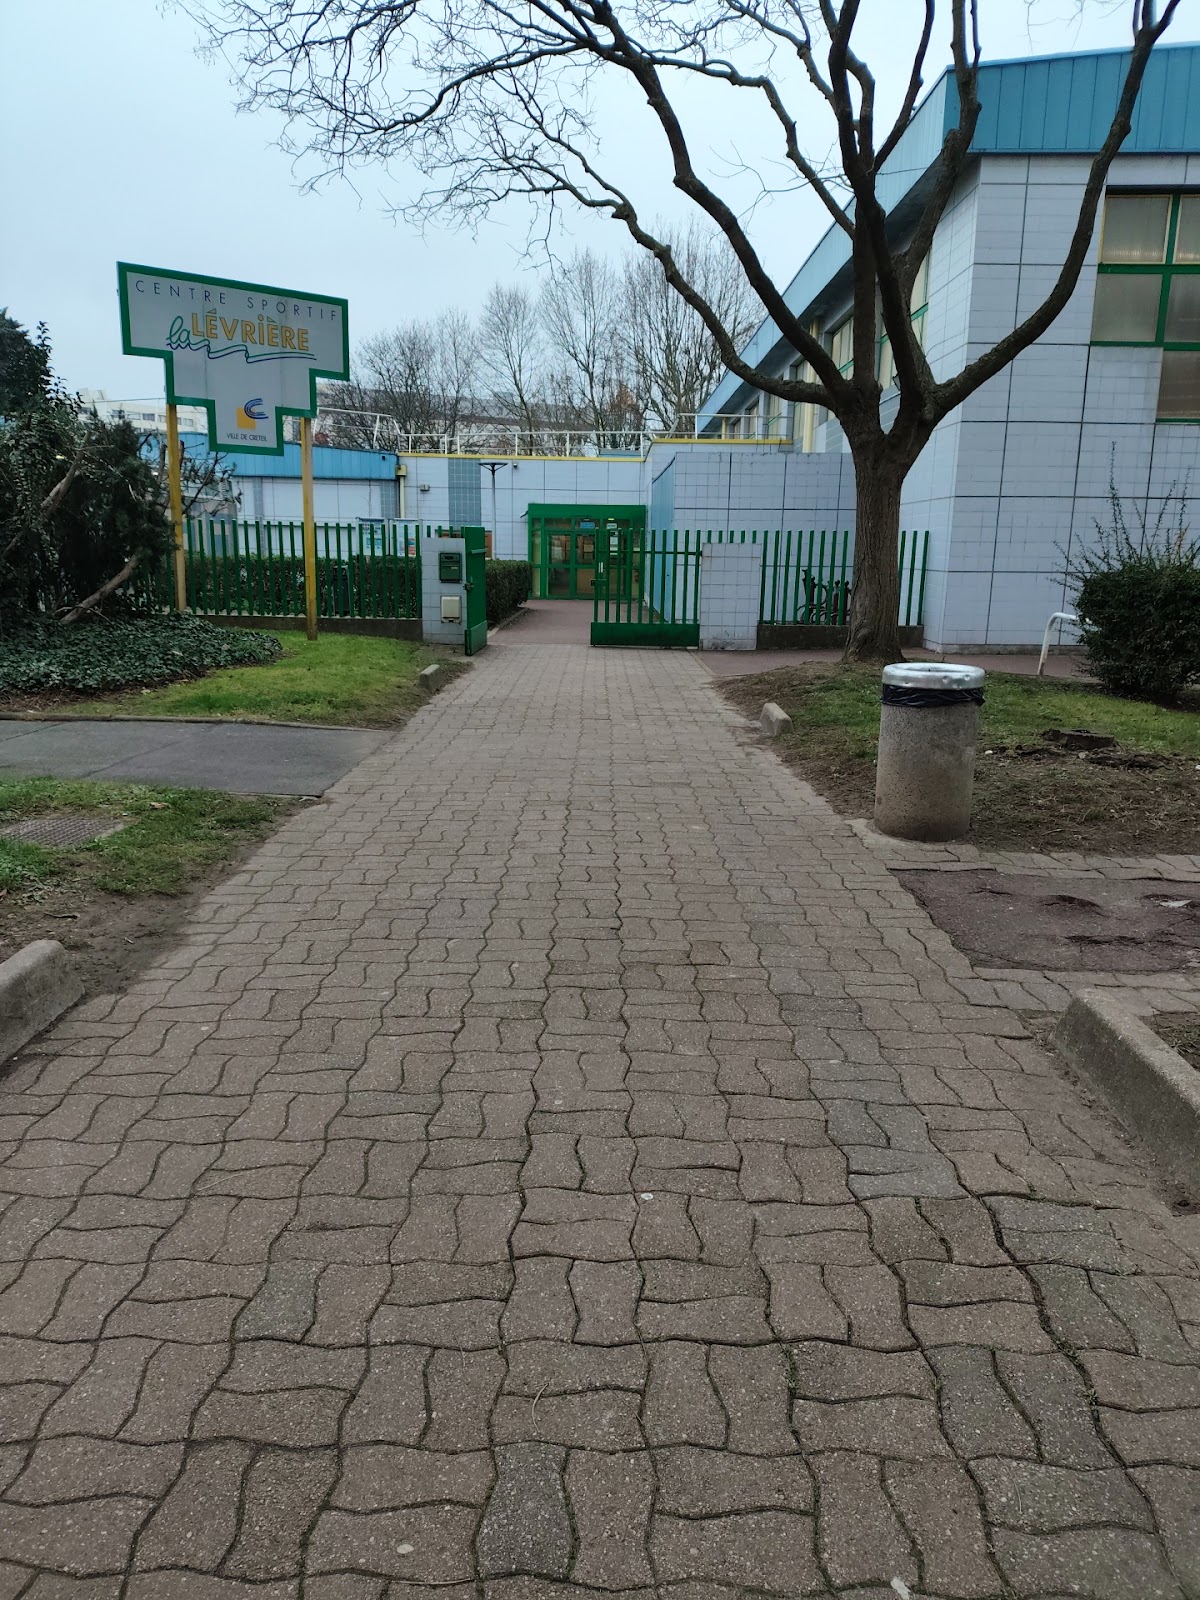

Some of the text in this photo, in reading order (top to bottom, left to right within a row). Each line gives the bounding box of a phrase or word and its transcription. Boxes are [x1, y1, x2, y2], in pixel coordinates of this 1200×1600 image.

[135, 280, 336, 321] CENTRE SPORTIF
[166, 315, 191, 345] la
[226, 432, 239, 440] VILLE
[240, 433, 248, 441] DE
